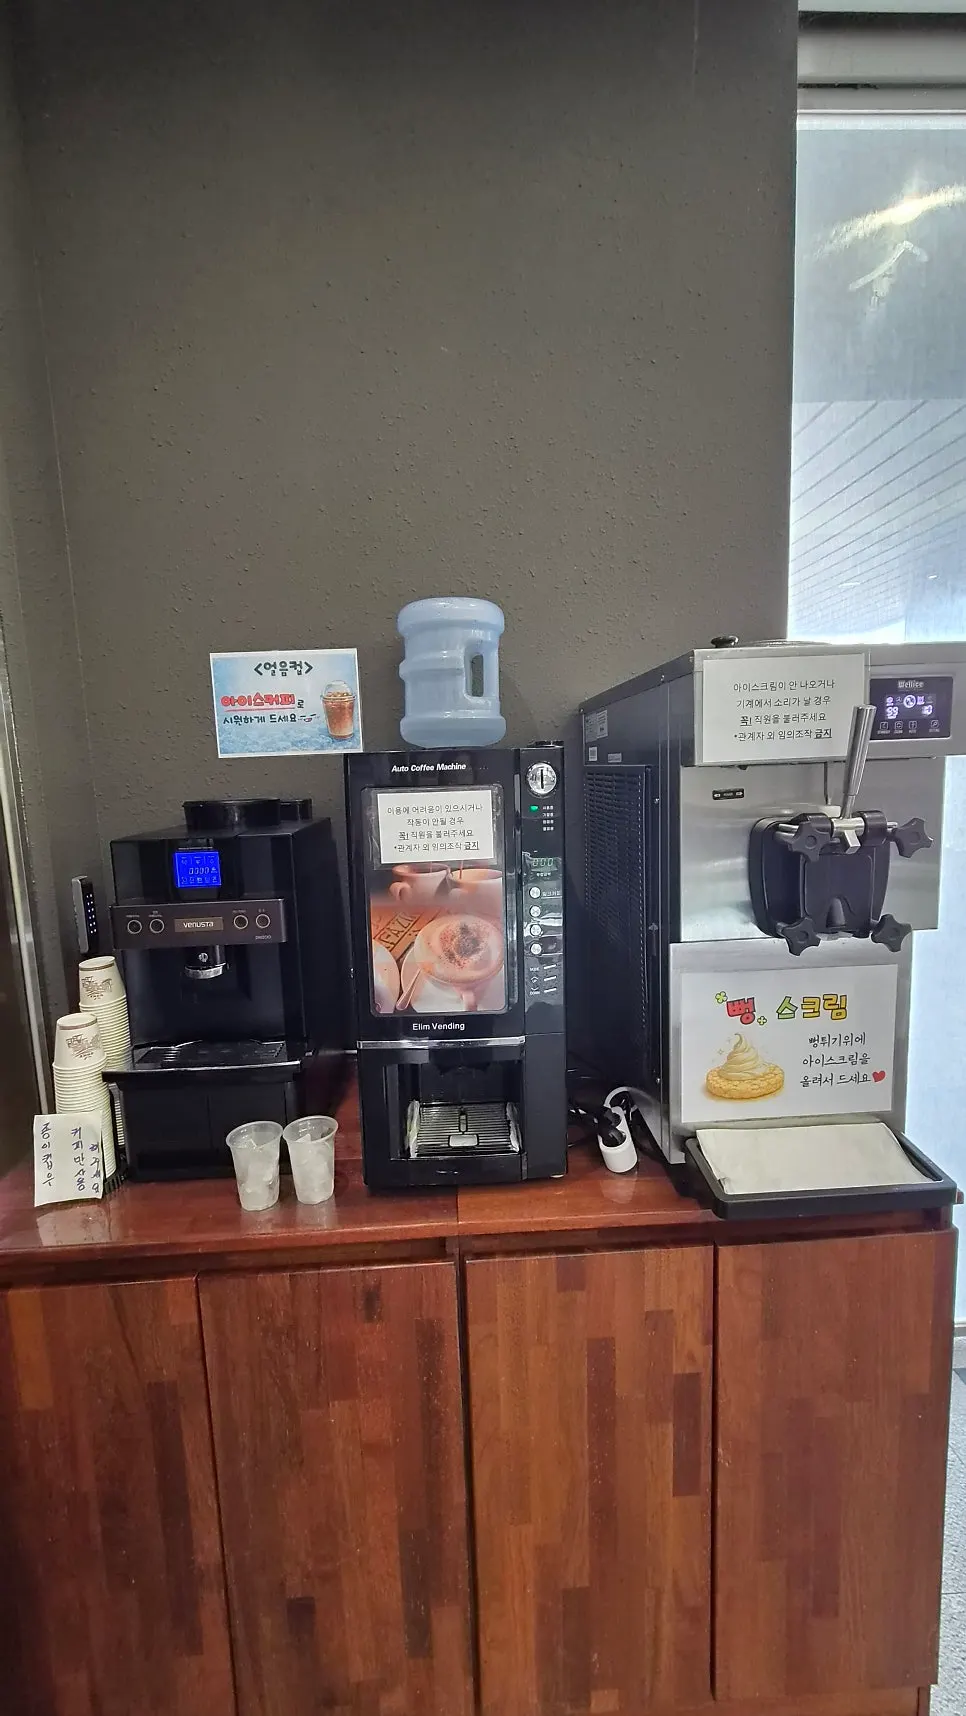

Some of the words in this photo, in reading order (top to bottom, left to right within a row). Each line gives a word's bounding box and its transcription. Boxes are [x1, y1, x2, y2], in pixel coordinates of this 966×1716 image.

[733, 681, 786, 693] 아이스크림이
[789, 680, 798, 691] 안
[800, 679, 835, 690] 나오거나
[736, 698, 772, 709] 기계에서
[774, 697, 801, 707] 소리가
[803, 696, 811, 706] 날
[814, 695, 831, 706] 경우
[222, 714, 266, 726] 시원하게
[740, 715, 752, 727] 꼭!
[754, 714, 781, 725] 직원을
[783, 712, 827, 724] 불러주세요
[766, 731, 775, 740] 외
[778, 729, 813, 740] 임의조작
[814, 728, 832, 739] 금지
[391, 765, 409, 773] Auto
[410, 764, 435, 772] Coffee
[436, 763, 467, 771] Machine
[387, 806, 410, 815] 이용에
[411, 805, 443, 814] 어려움이
[444, 803, 483, 813] 있으시거나
[406, 818, 430, 827] 작동이
[431, 817, 447, 826] 안될
[449, 816, 465, 825] 경우
[398, 831, 409, 840] 꼭!
[411, 830, 433, 839] 직원을
[435, 829, 474, 838] 불러주세요
[422, 843, 430, 851] 외
[432, 842, 462, 851] 임의조작
[464, 841, 480, 850] 금지
[726, 996, 756, 1025] 뻥
[776, 993, 848, 1021] 스크림
[412, 1023, 431, 1031] Elim
[431, 1022, 466, 1031] Vending
[808, 1031, 866, 1048] 뻥튀기위에
[802, 1052, 871, 1067] 아이스크림을
[800, 1073, 834, 1088] 올려서
[836, 1071, 871, 1085] 드세요
